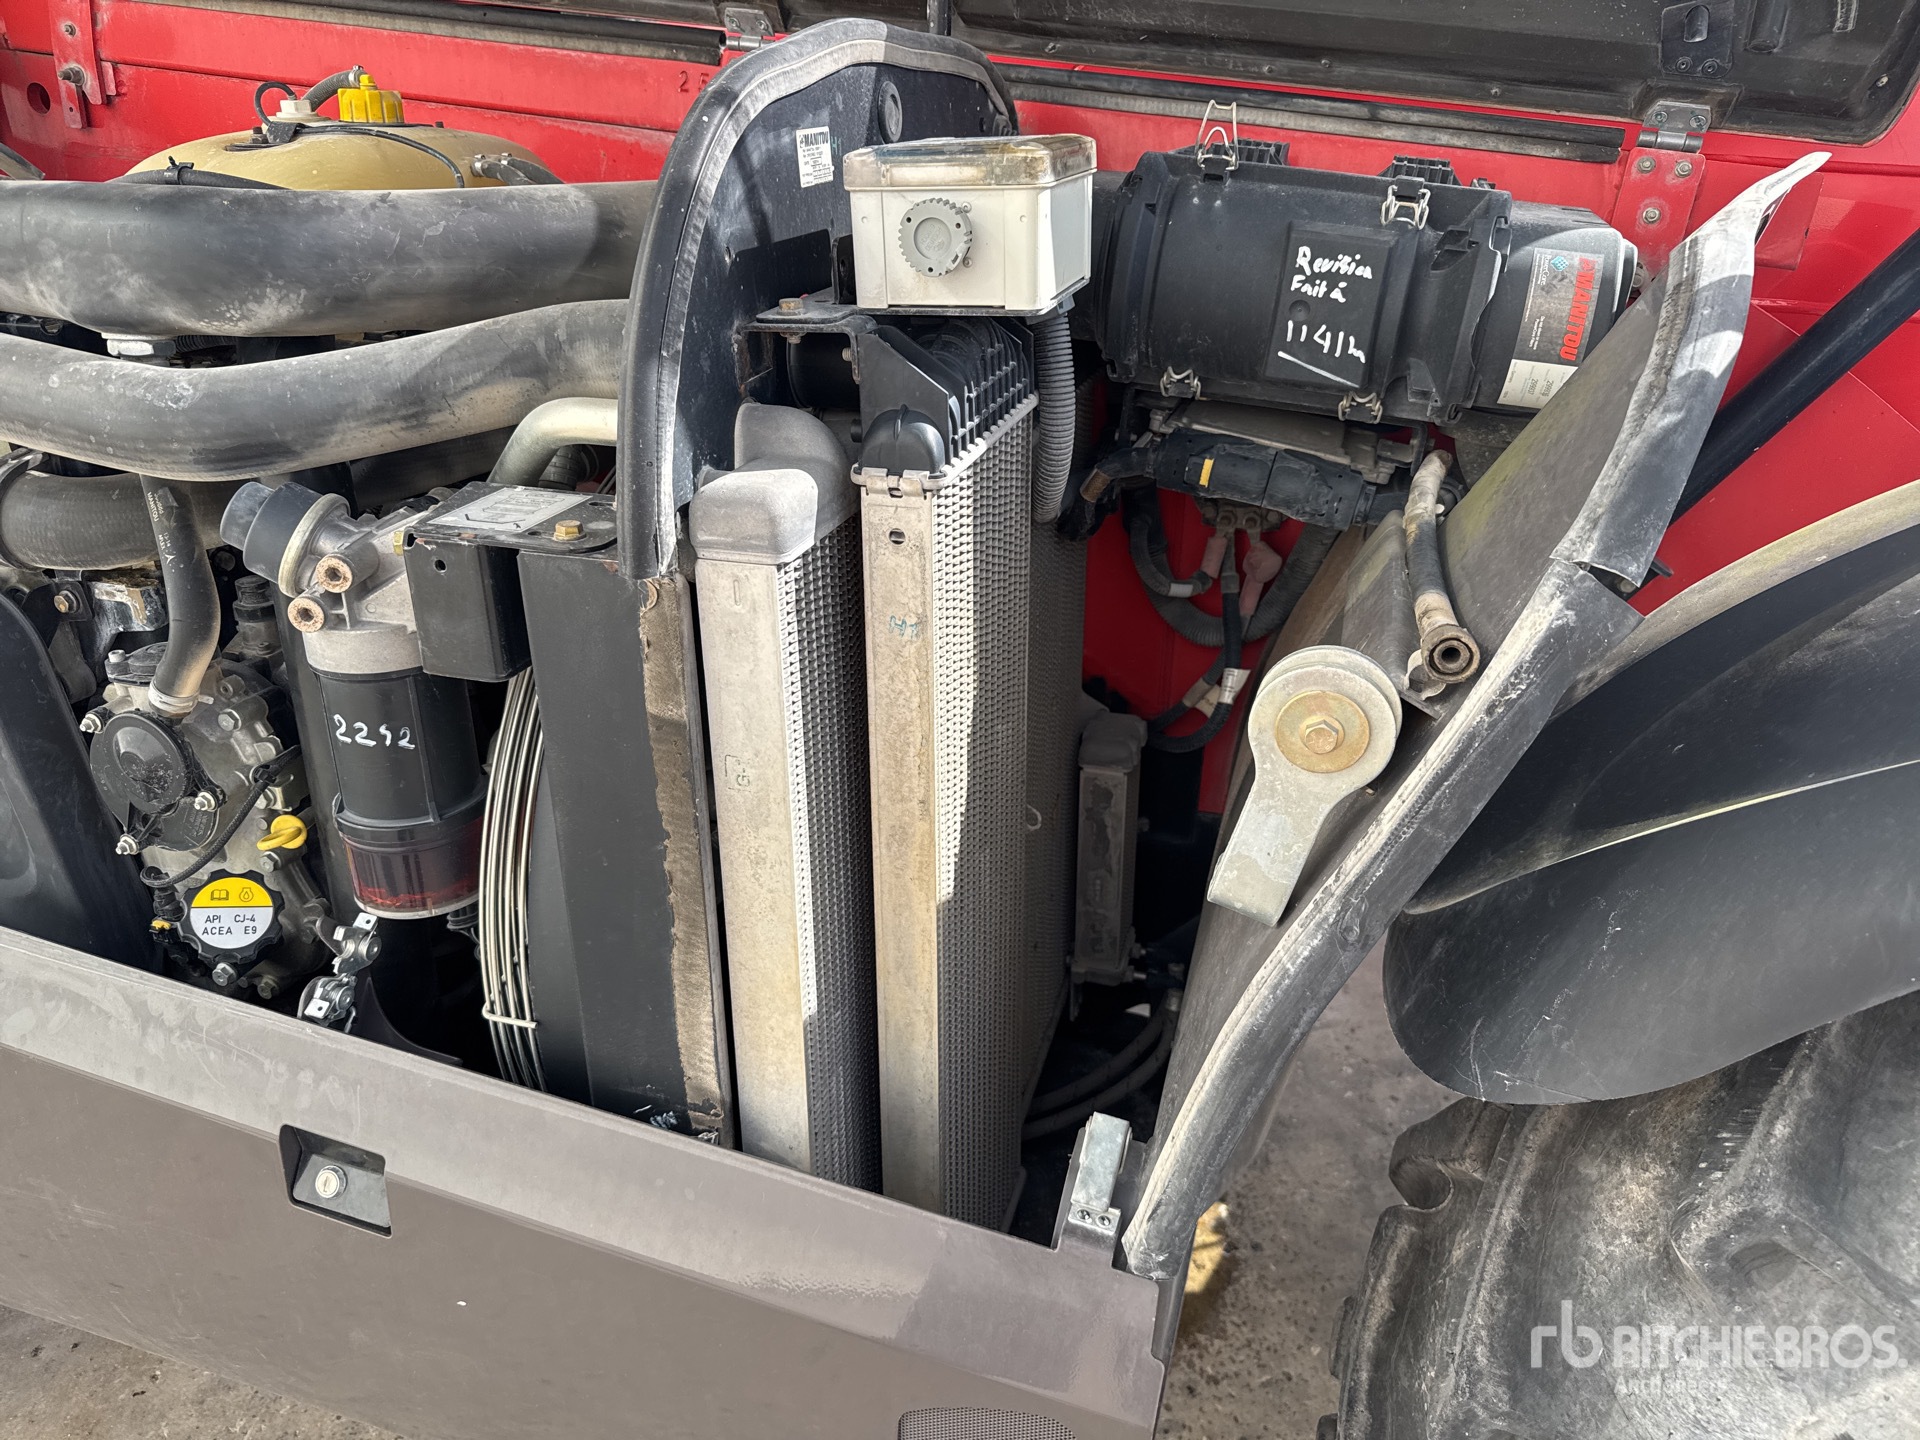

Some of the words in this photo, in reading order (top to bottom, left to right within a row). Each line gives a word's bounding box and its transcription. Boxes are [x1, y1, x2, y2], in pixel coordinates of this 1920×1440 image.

[804, 131, 829, 147] MANITOU
[1560, 271, 1596, 361] MANITOU
[147, 491, 160, 521] MANITOU
[205, 915, 221, 923] API
[234, 914, 256, 923] CJ-4
[202, 926, 233, 936] ACEA
[244, 926, 257, 935] E9
